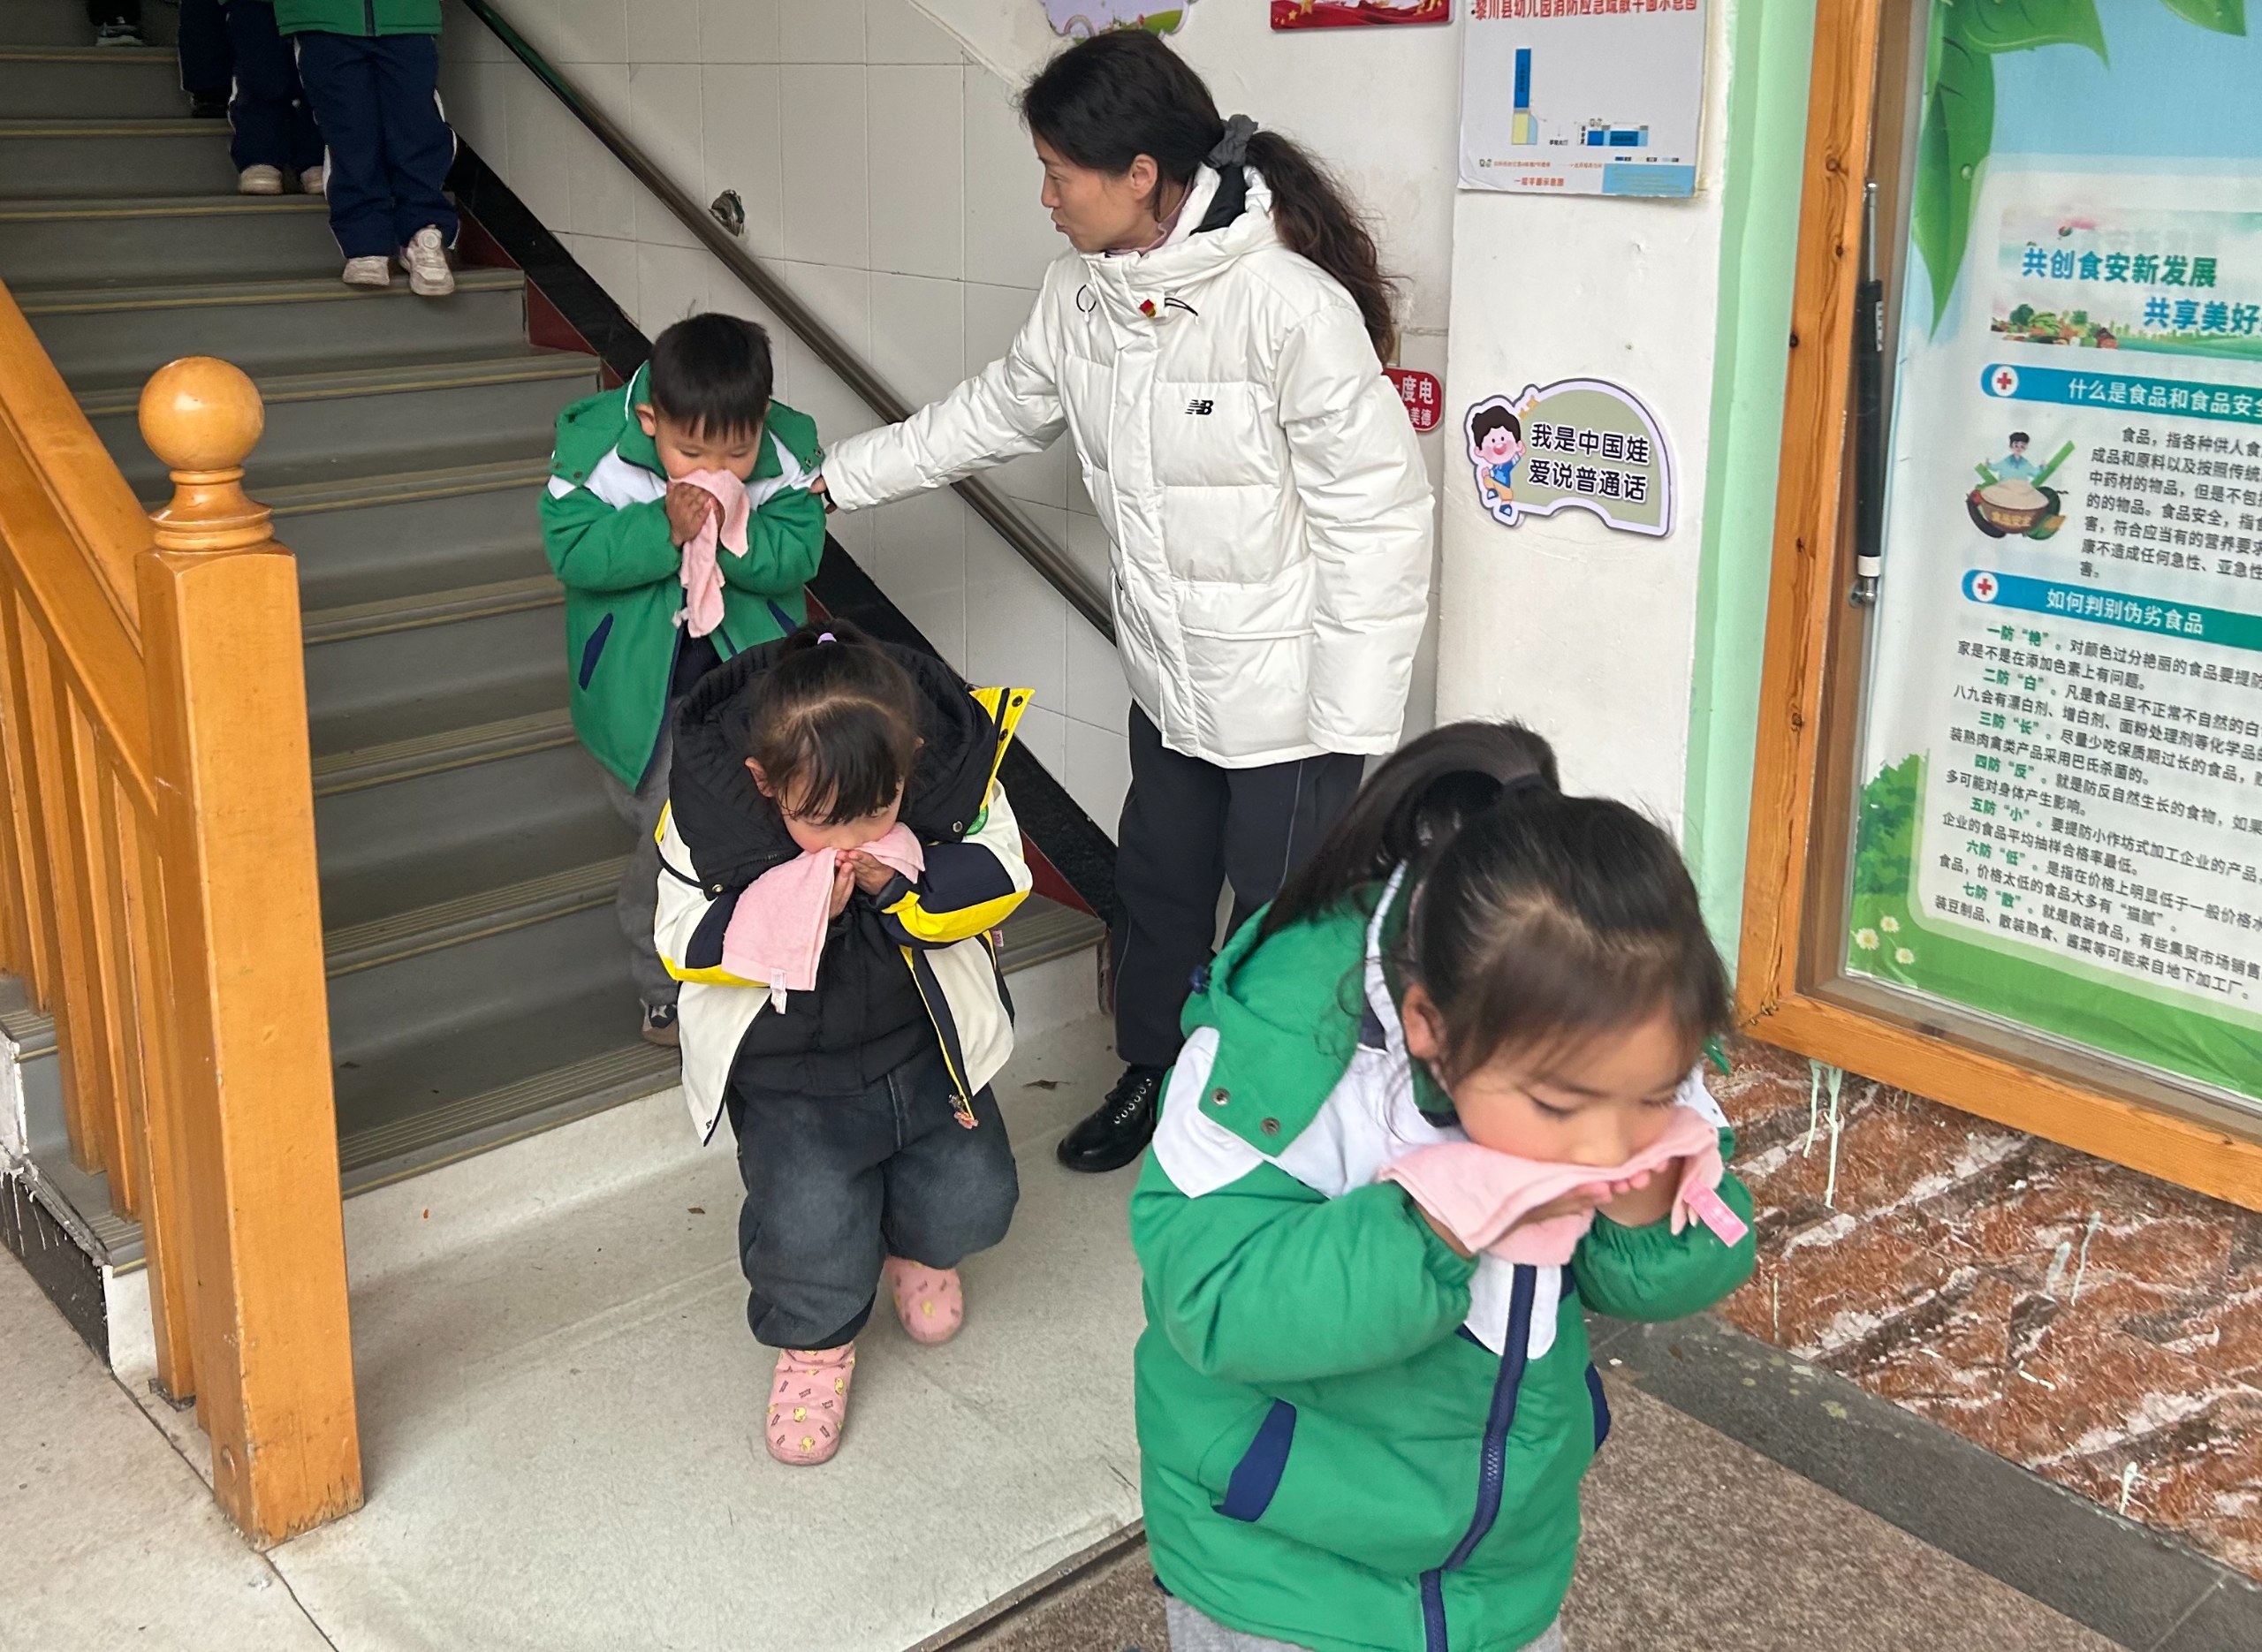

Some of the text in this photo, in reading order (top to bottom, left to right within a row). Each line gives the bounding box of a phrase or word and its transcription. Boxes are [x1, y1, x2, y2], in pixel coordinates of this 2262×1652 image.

[2021, 247, 2217, 287] 共创食安新发展
[2144, 297, 2262, 336] 共享美好
[1395, 375, 1434, 404] 度电
[1531, 423, 1649, 464] 我是中国娃
[1529, 458, 1646, 501] 爱说普通话
[2046, 587, 2204, 635] 如何判别伪劣食品
